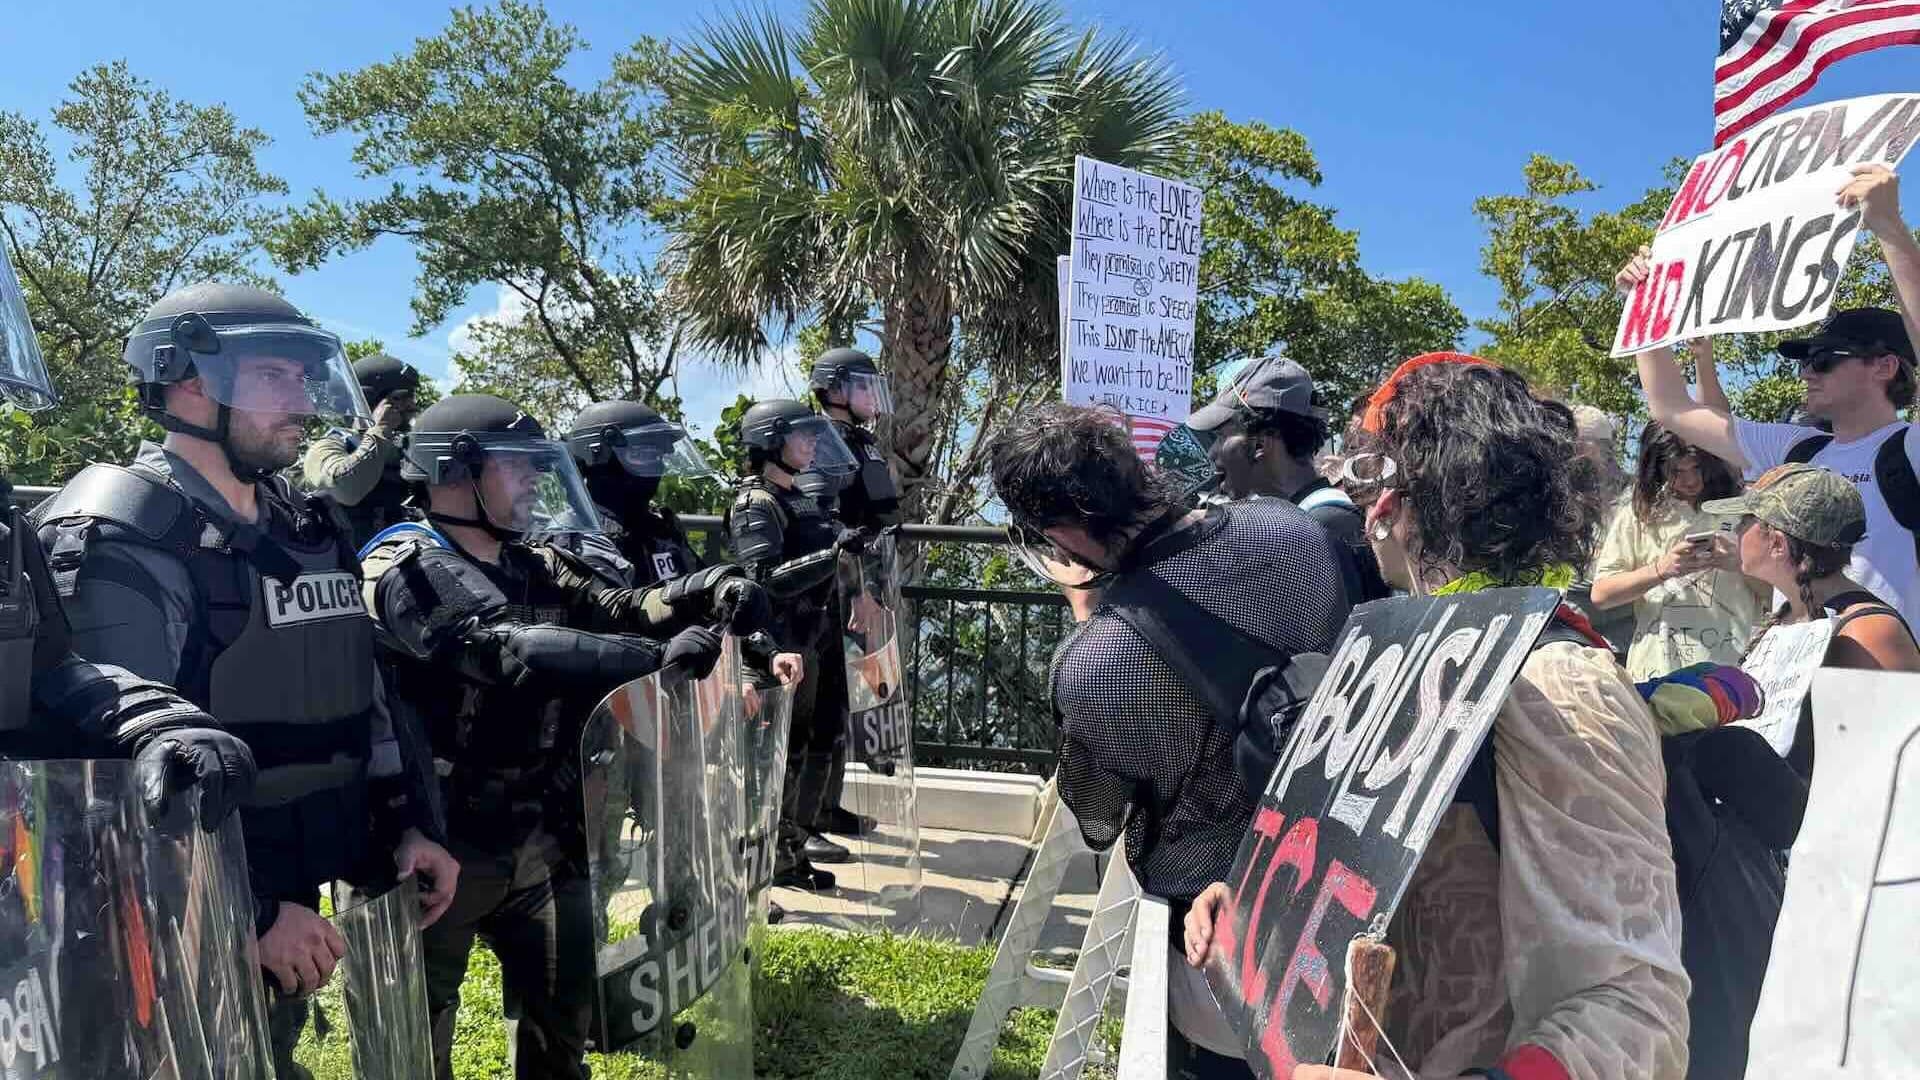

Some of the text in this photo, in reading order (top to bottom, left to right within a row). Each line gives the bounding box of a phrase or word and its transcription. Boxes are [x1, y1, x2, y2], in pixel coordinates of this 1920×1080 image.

[1080, 159, 1118, 202] Where
[1122, 176, 1135, 204] is
[1135, 178, 1159, 214] the
[1660, 138, 1747, 231] NO
[1079, 200, 1116, 238] Where
[1119, 212, 1129, 241] is
[1132, 215, 1159, 249] the
[1075, 237, 1101, 282] They
[1144, 260, 1155, 279] us
[1620, 210, 1862, 349] NO KINGS
[1073, 281, 1100, 318] They
[1071, 318, 1100, 348] This
[1139, 324, 1157, 355] the
[1135, 359, 1153, 389] to
[1157, 362, 1189, 395] be!!!
[1136, 397, 1159, 414] ICE
[274, 579, 359, 616] POLICE
[1263, 603, 1548, 853] ABOLISH
[1214, 806, 1378, 1080] ICE
